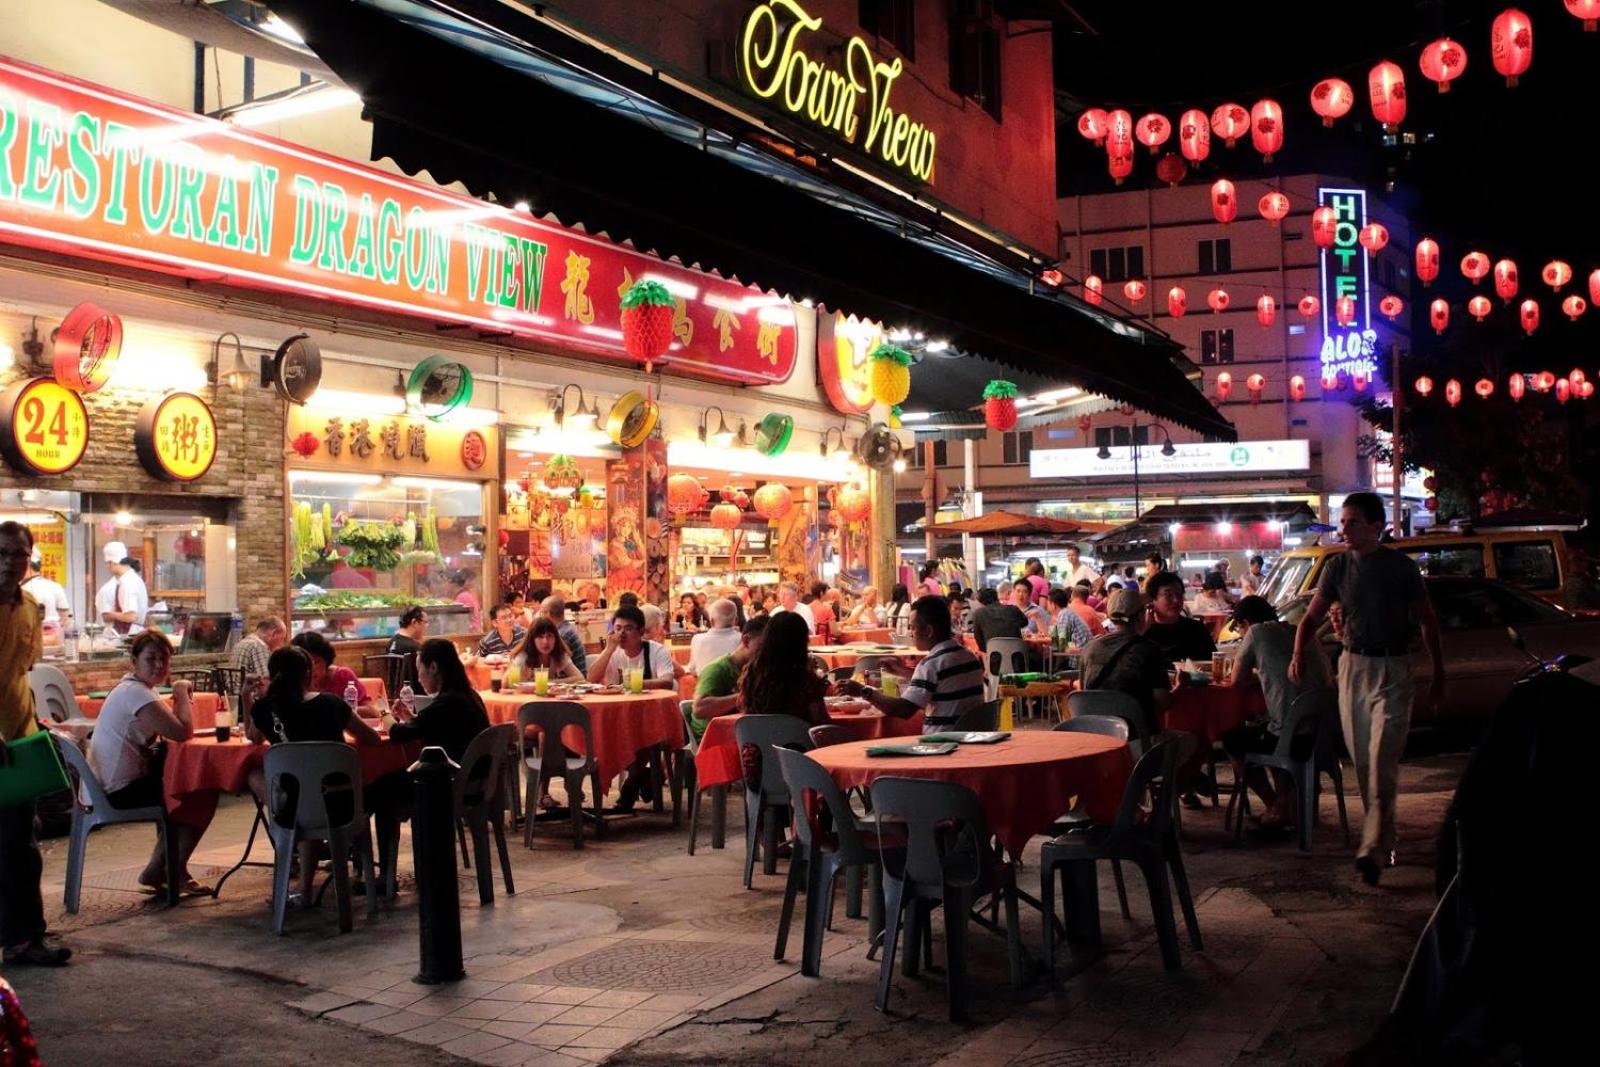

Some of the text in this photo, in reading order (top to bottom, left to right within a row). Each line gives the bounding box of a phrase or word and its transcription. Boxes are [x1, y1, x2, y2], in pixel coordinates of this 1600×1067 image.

[744, 0, 935, 180] Town View
[290, 174, 451, 296] DRAGON
[464, 220, 548, 313] VIEW
[1332, 195, 1358, 327] HOTE
[23, 396, 69, 447] 24
[35, 449, 61, 459] HOUR
